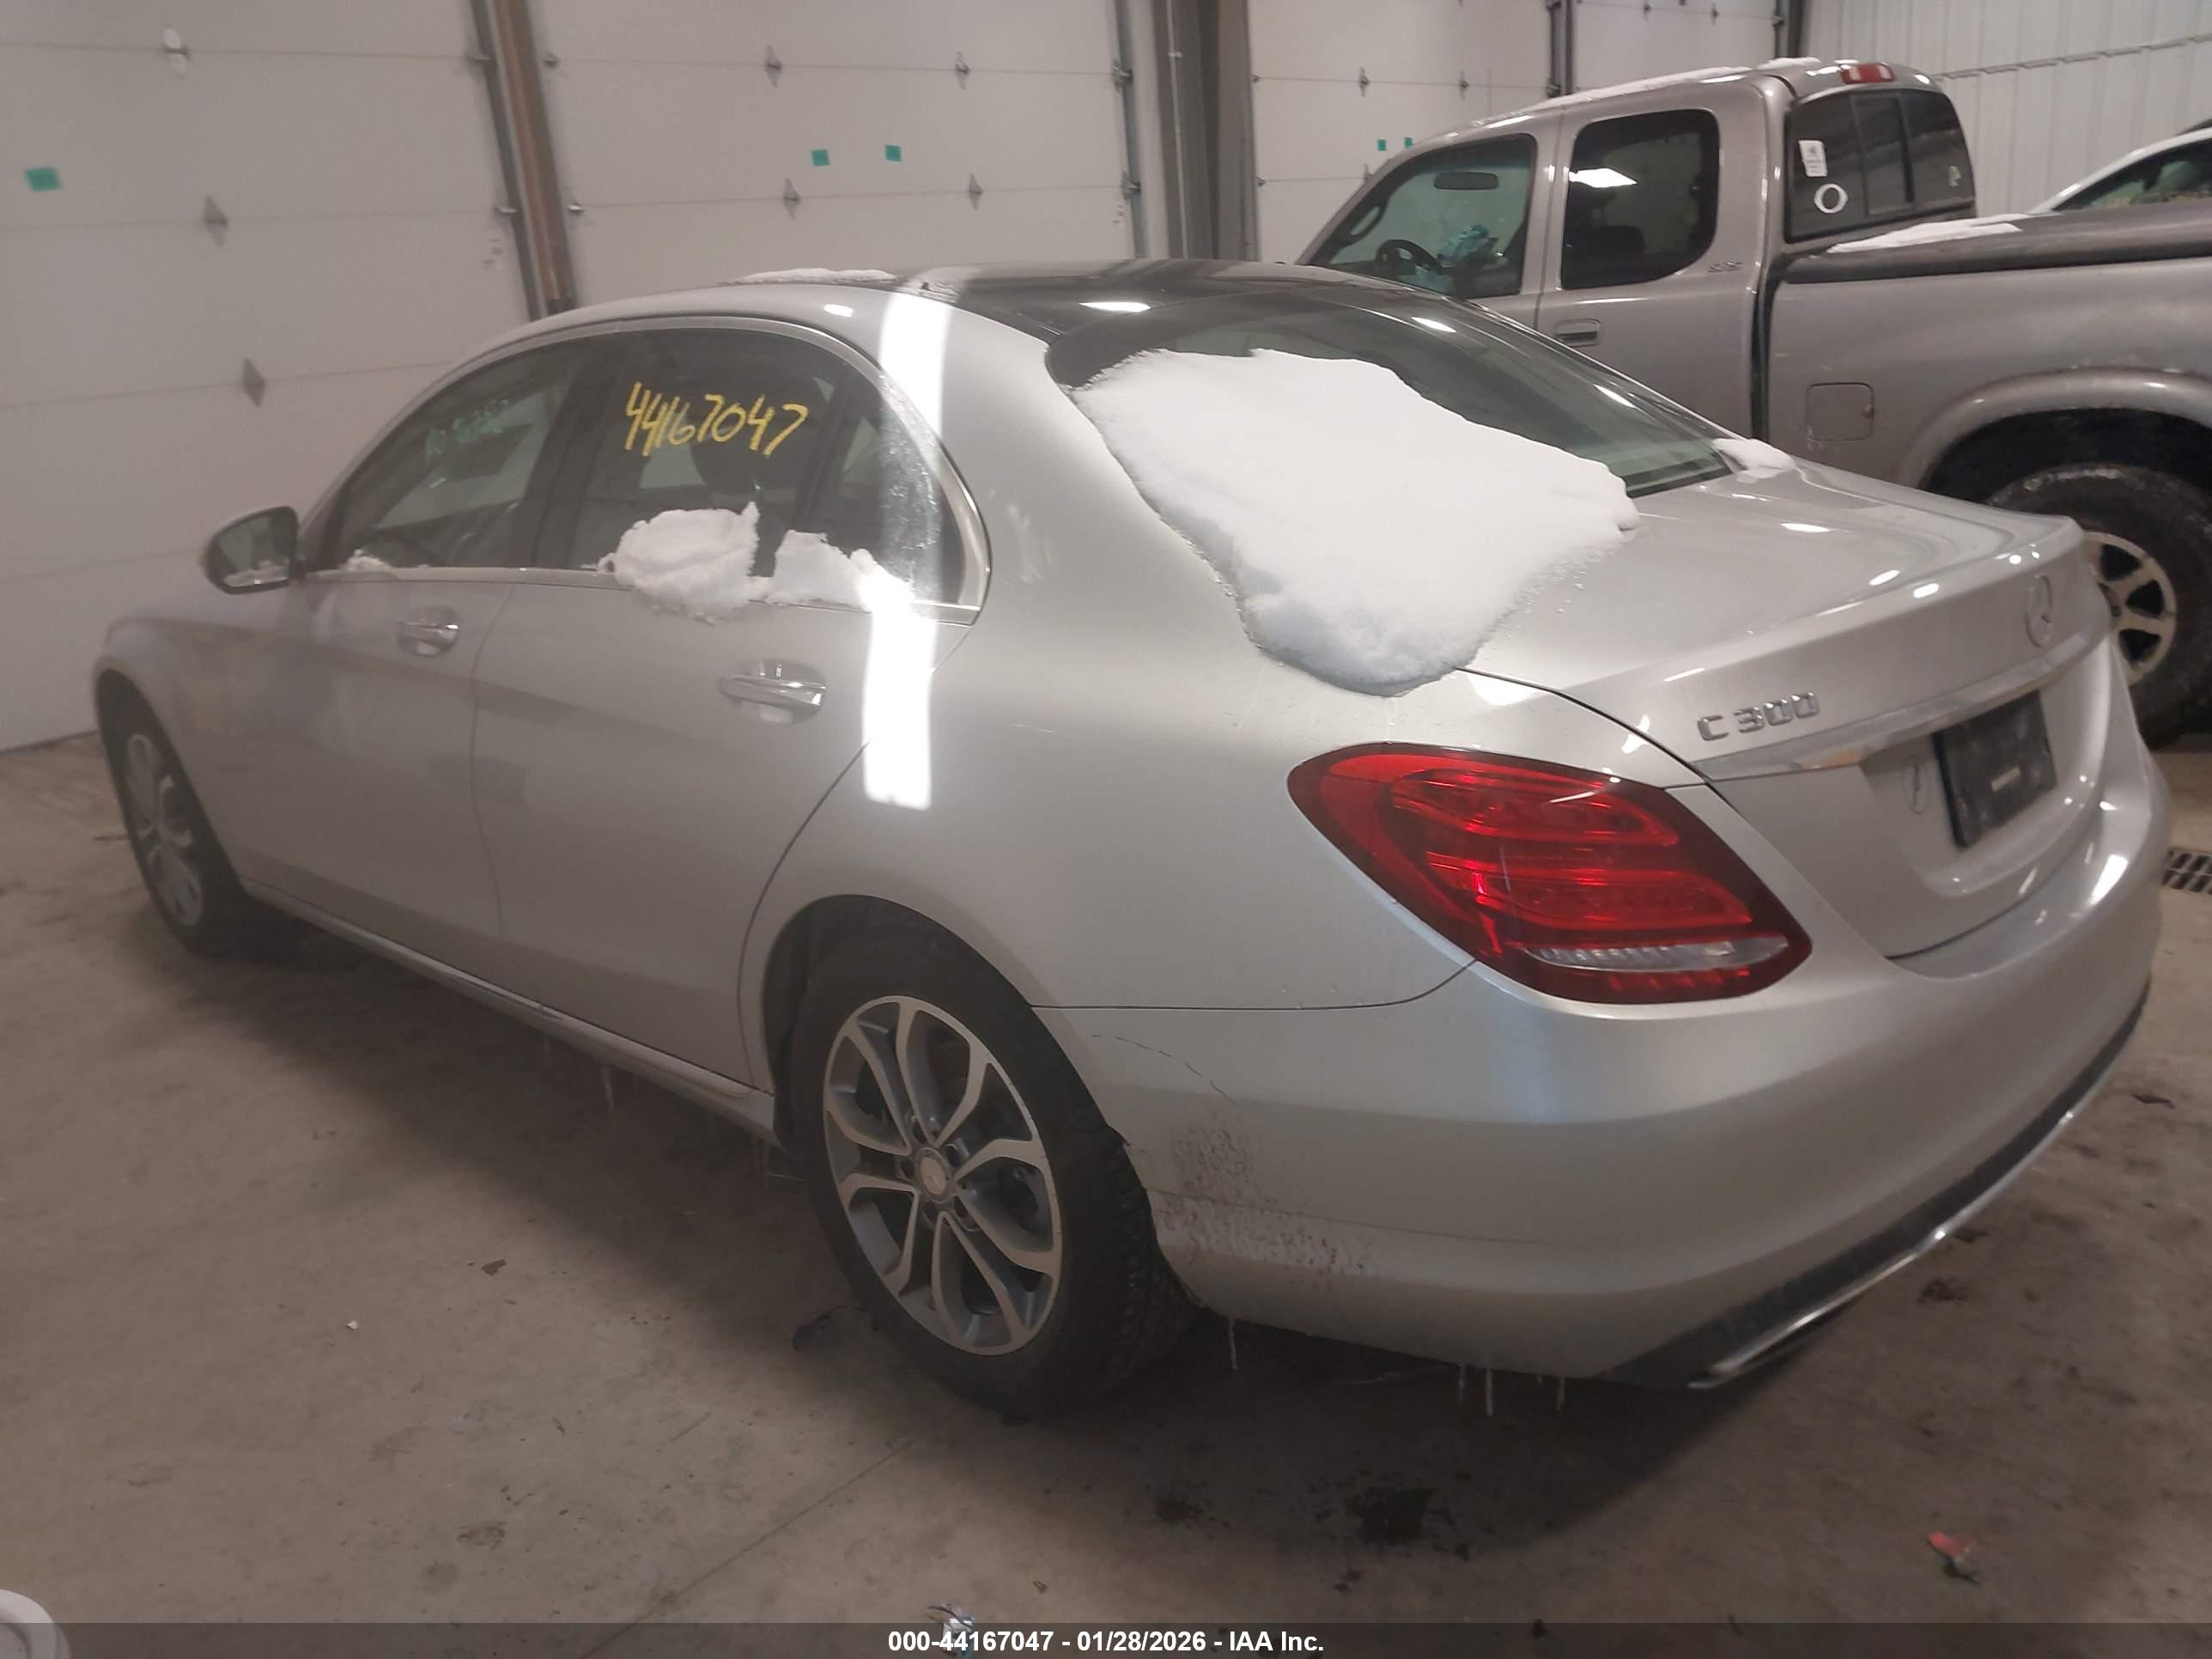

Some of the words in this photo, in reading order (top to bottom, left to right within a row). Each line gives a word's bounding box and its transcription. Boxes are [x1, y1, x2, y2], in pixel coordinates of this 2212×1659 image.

[624, 381, 809, 457] 44167047
[1697, 714, 1729, 741] C
[1733, 691, 1820, 733] 300
